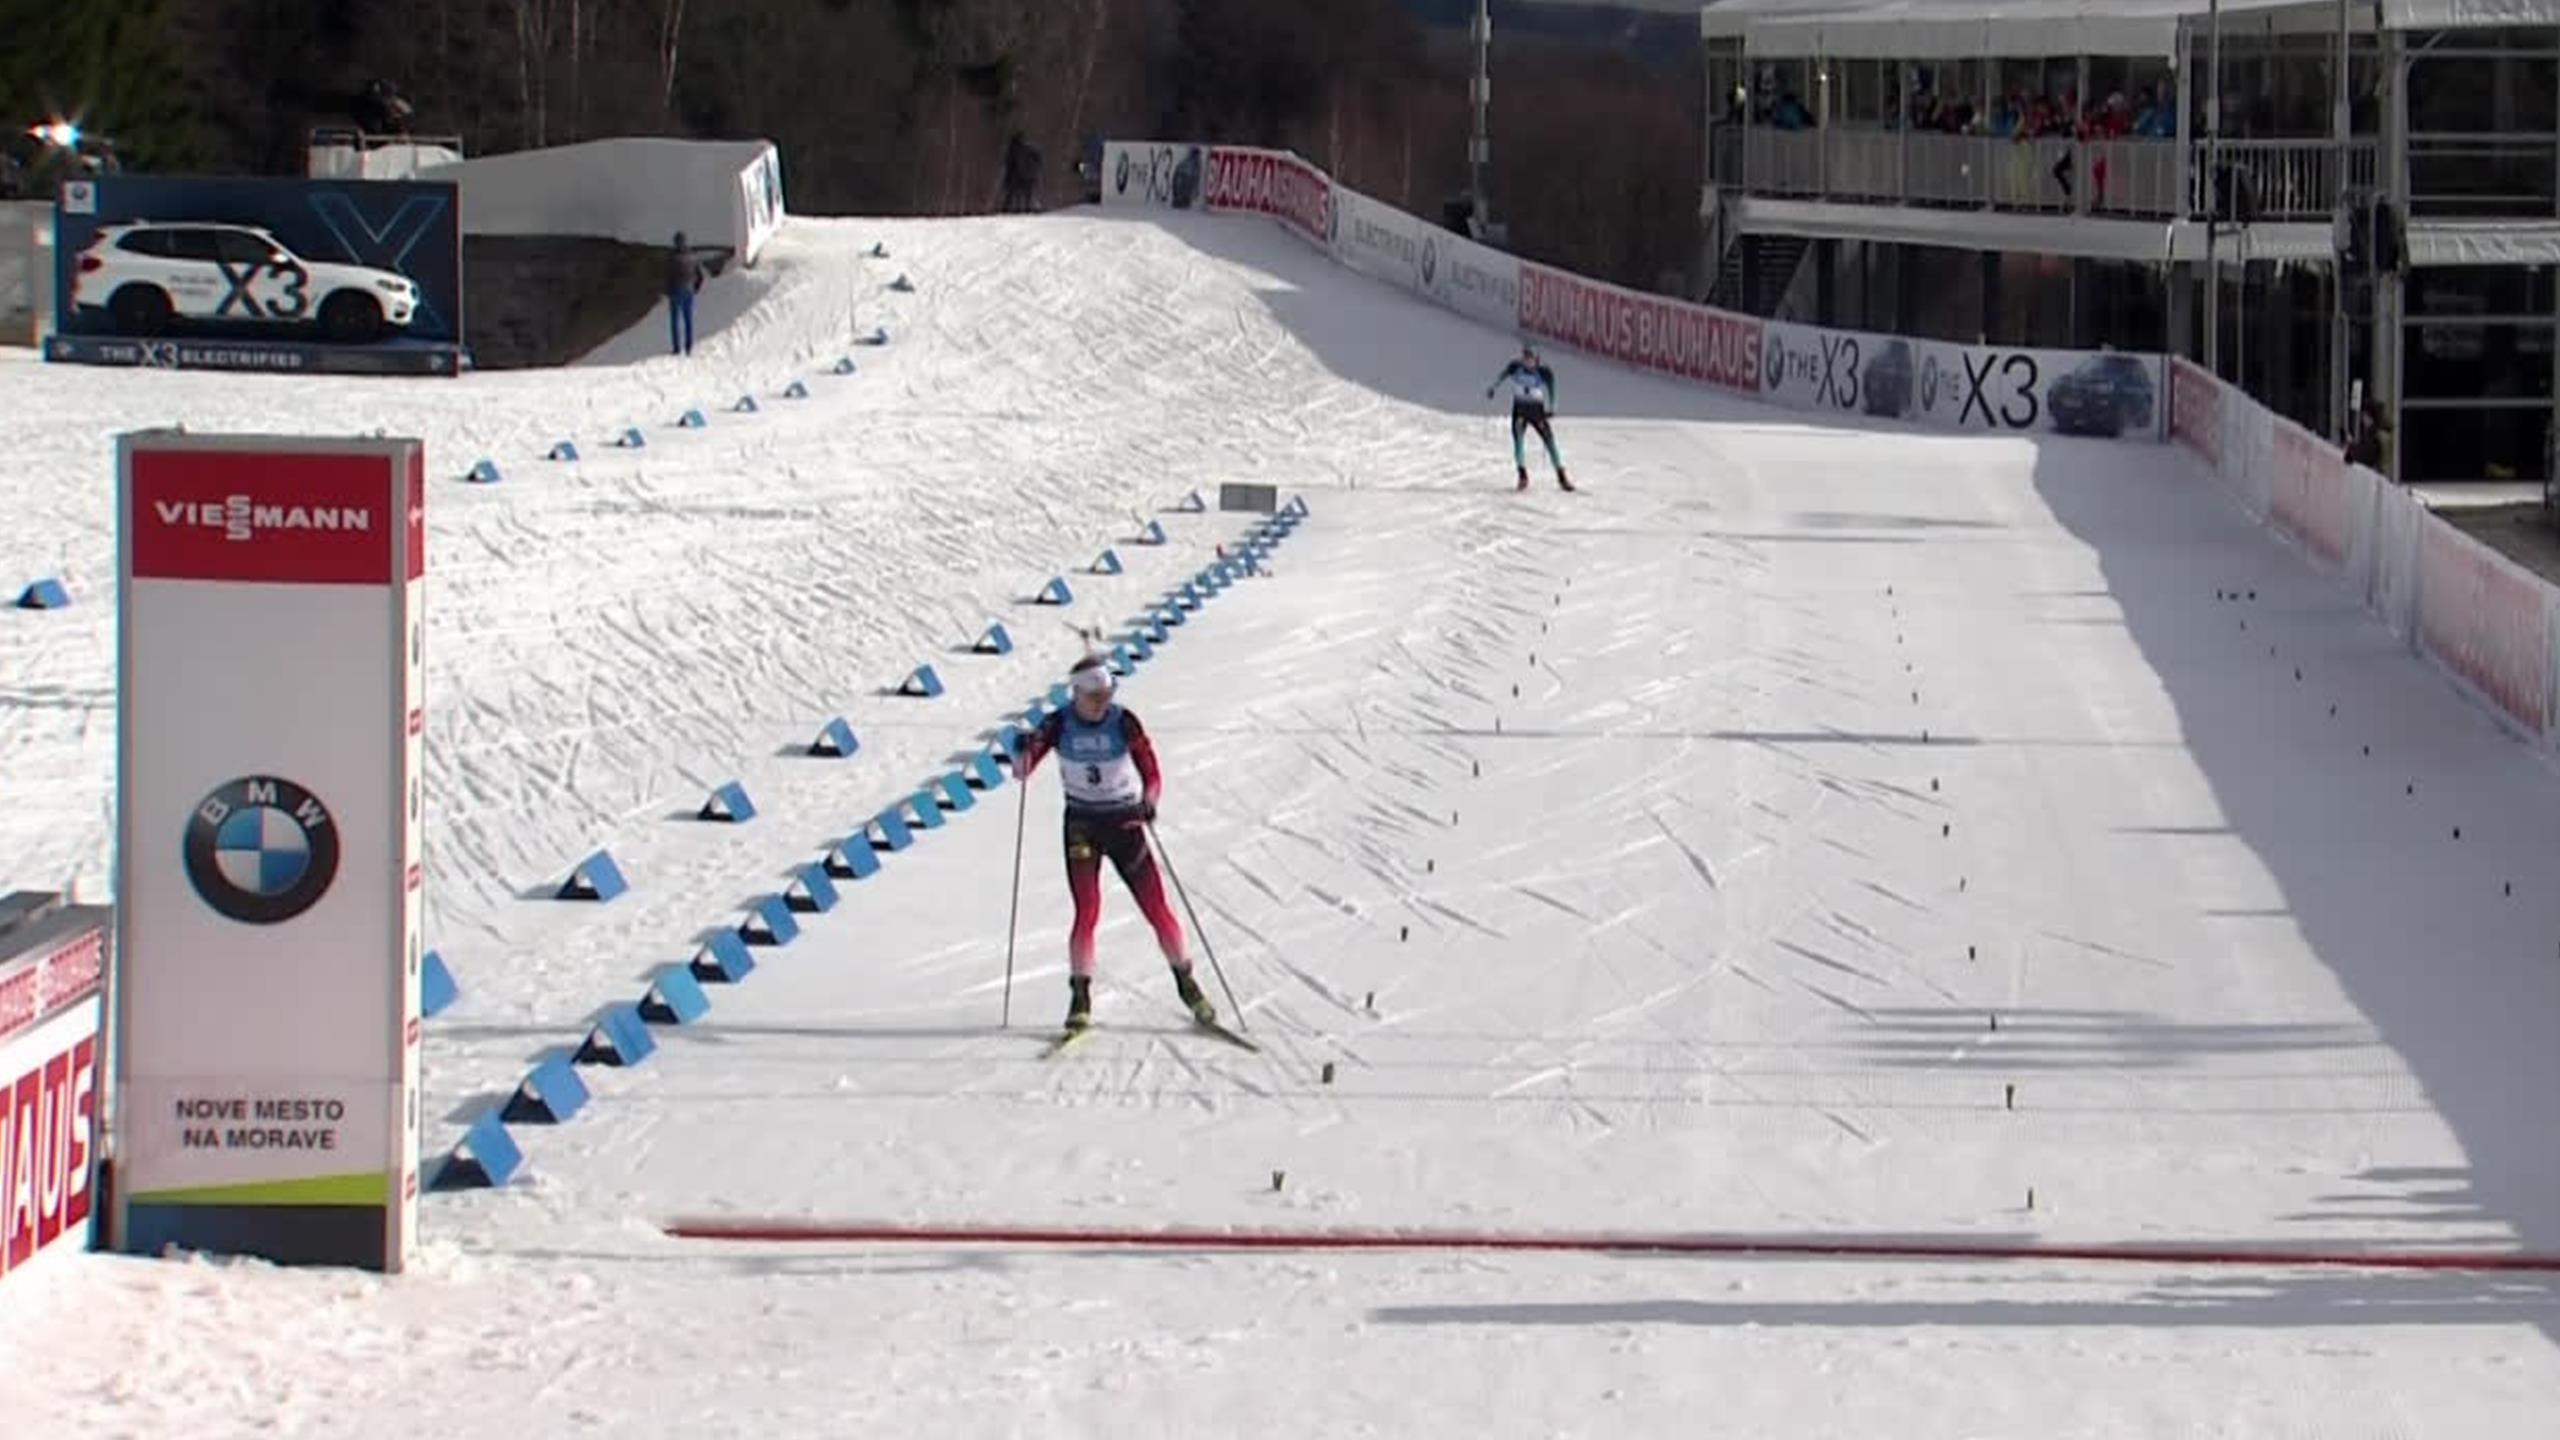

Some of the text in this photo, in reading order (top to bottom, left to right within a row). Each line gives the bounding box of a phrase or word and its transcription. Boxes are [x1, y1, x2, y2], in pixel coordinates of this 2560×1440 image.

[1147, 146, 1173, 203] X3
[216, 258, 308, 320] X3
[1521, 275, 1759, 380] BAUHAUS BAUHAUS
[100, 341, 303, 368] THE X3 ELECTRIFIED
[1787, 334, 1860, 409] THE X3
[1959, 352, 2039, 429] X3
[155, 495, 369, 540] VIESSMANN
[1086, 763, 1102, 786] 3
[200, 779, 326, 828] BMW
[176, 1100, 344, 1121] NOVE MESTO
[183, 1128, 335, 1149] NA MORAVE
